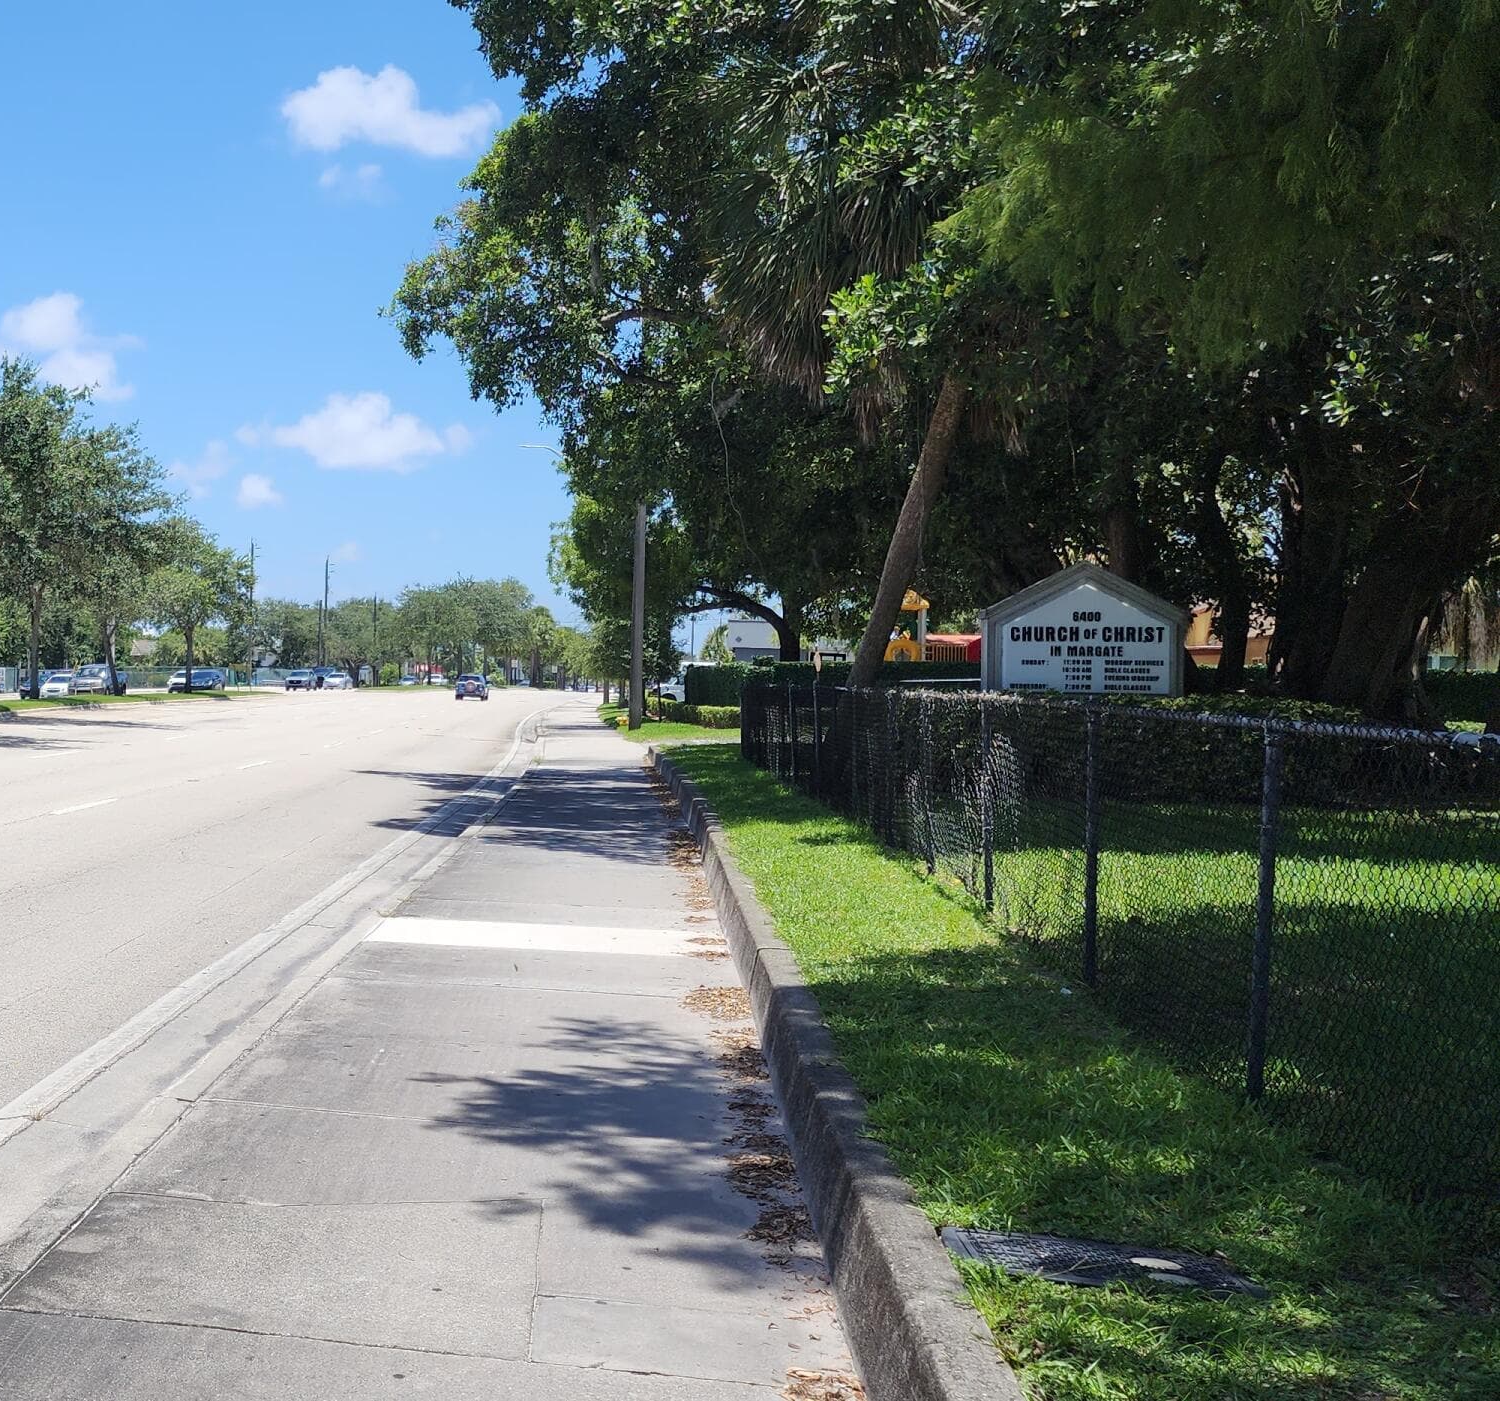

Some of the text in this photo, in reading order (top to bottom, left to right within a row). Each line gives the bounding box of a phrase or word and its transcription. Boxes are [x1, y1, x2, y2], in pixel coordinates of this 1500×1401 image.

[1072, 611, 1101, 622] 6400
[1010, 626, 1165, 643] CHURCH OF CHRIST
[1050, 645, 1124, 657] IN MARGATE
